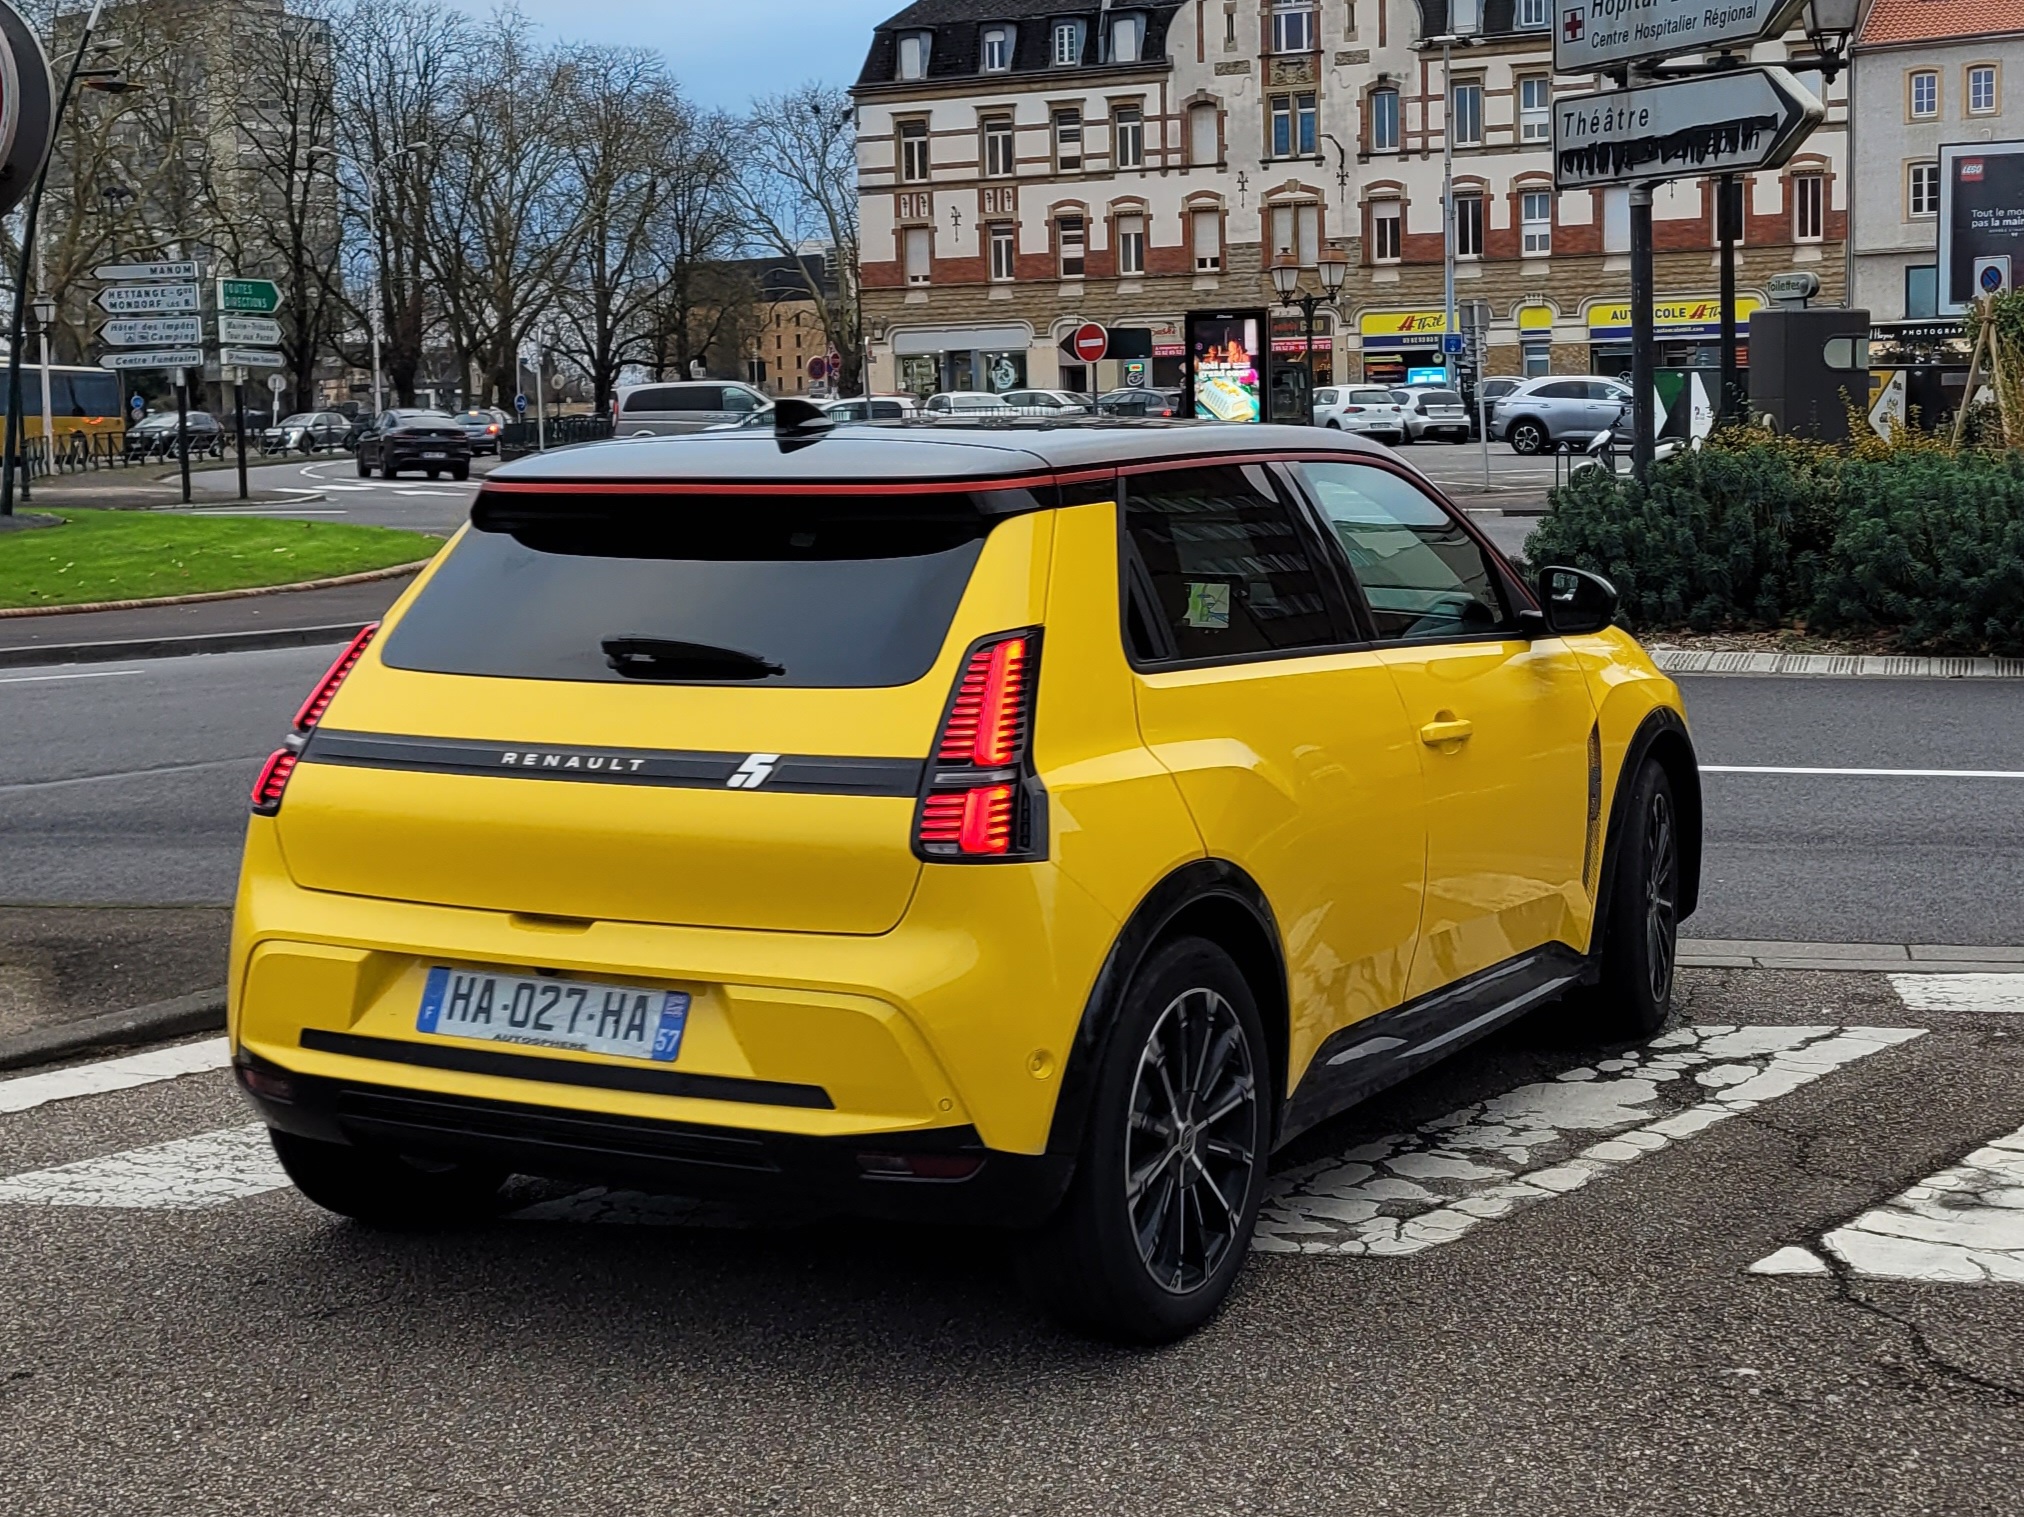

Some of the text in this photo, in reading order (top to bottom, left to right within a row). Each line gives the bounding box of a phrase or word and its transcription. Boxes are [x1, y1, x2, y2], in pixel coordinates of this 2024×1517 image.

[1591, 1, 1758, 48] Centre Hospitalier Régional
[1563, 107, 1649, 137] Théâtre
[1971, 207, 2024, 218] Tout le mo
[1971, 219, 1989, 229] pas
[1991, 218, 2000, 227] la
[149, 265, 192, 275] MANOM
[224, 283, 253, 295] TOUTES
[1766, 280, 1801, 292] Toilettes
[108, 300, 162, 310] MONDORF
[225, 296, 267, 309] DIRECTIONS
[1653, 307, 1687, 319] COLE
[110, 322, 195, 332] Hôtel des Impôts
[150, 333, 196, 342] Camping
[115, 355, 197, 366] Centre Funéraire
[501, 752, 645, 771] RENAULT
[726, 753, 780, 788] 5
[424, 1005, 435, 1020] F
[446, 975, 650, 1042] HA-027-HA
[493, 1033, 588, 1051] AUTOSPHERE
[654, 1028, 681, 1052] 57
